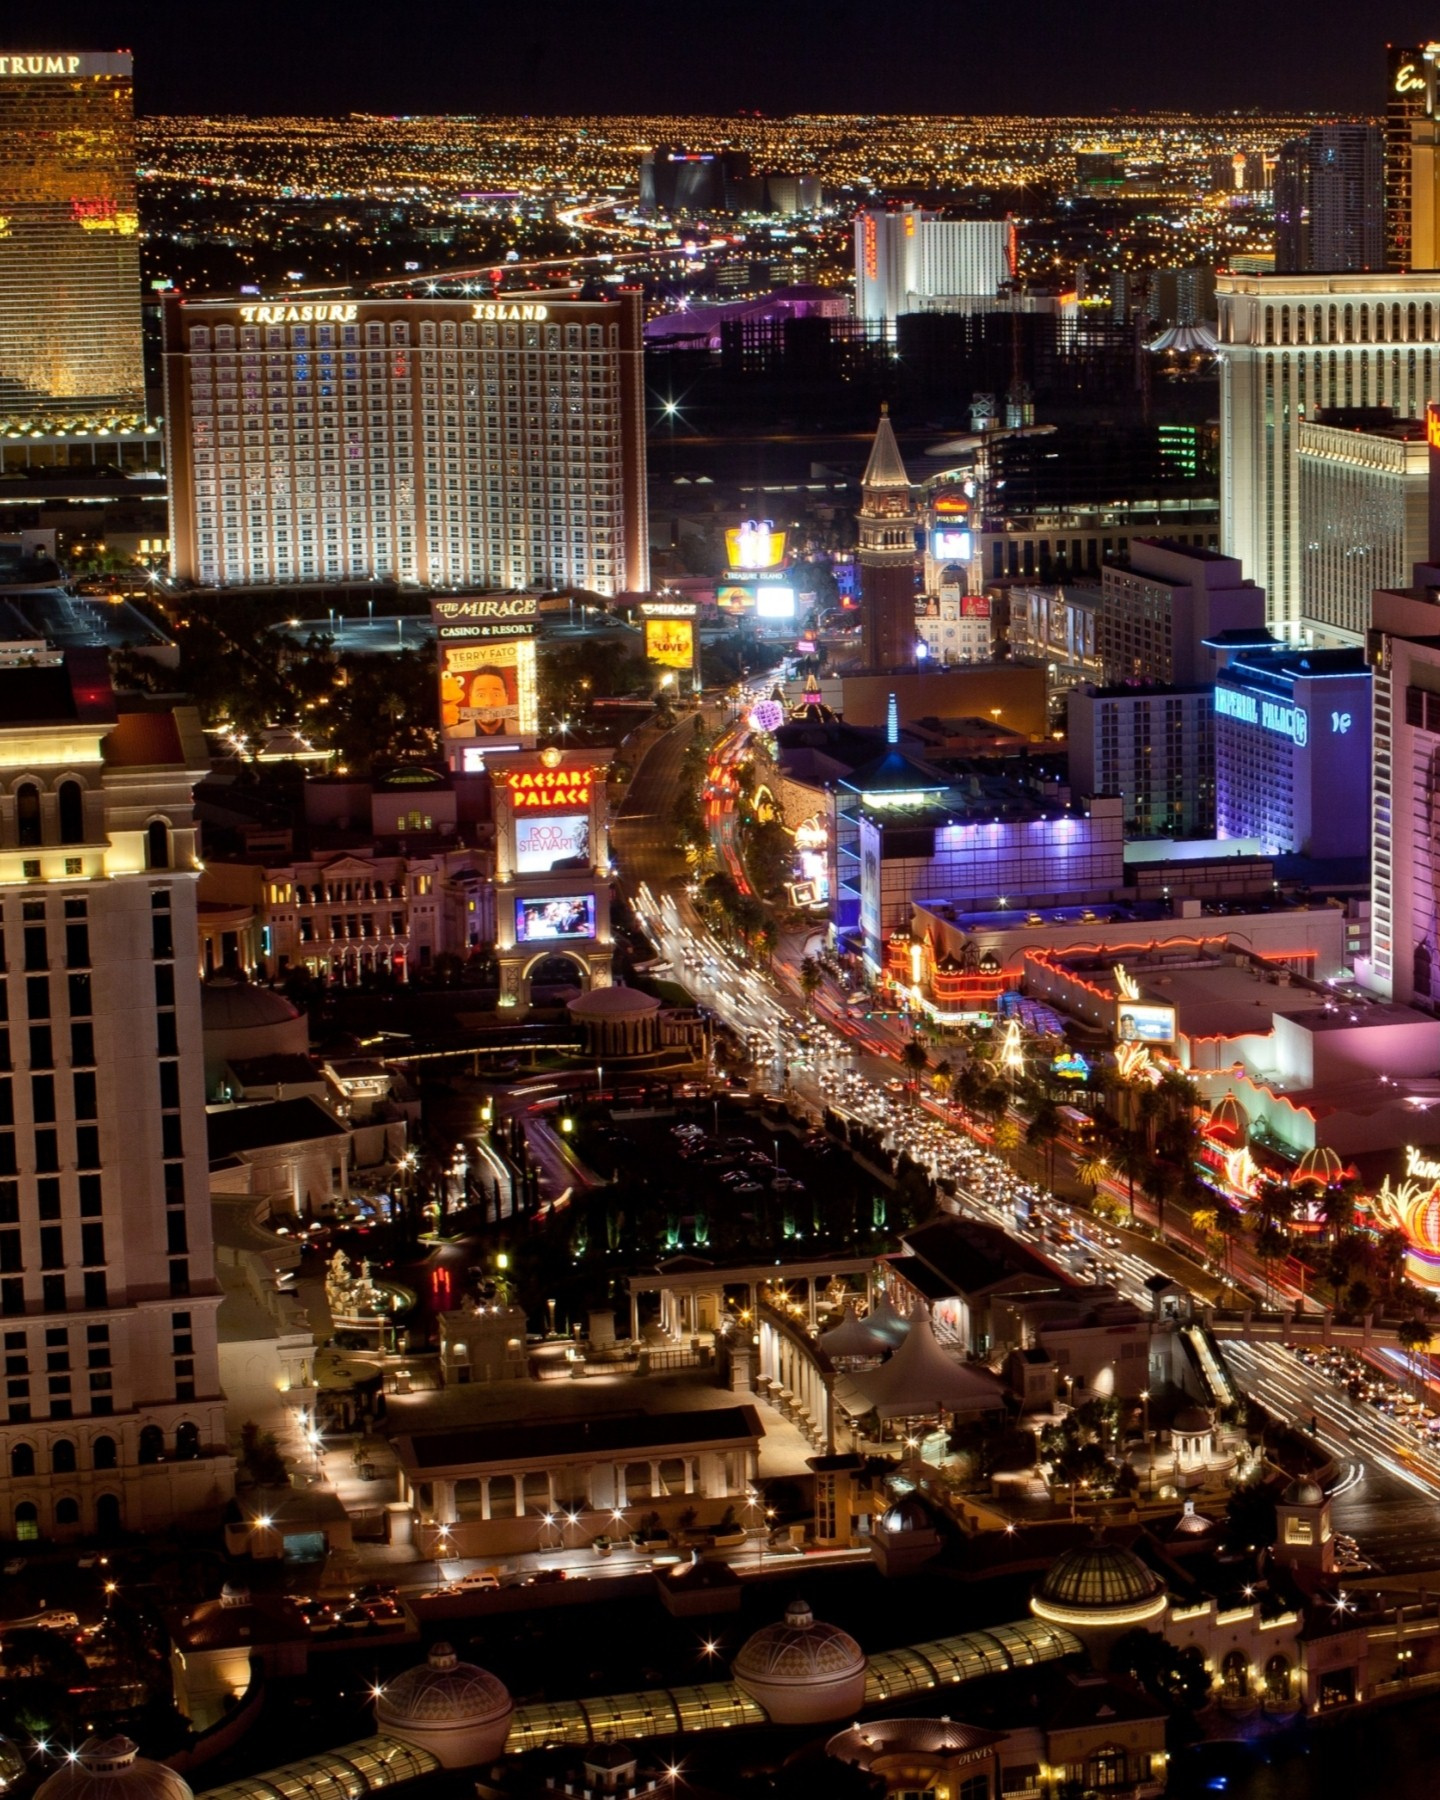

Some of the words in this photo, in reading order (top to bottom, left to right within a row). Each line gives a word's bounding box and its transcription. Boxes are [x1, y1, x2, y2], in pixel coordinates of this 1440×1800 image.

[0, 56, 80, 74] TRUMP
[240, 305, 358, 324] TREASURE
[472, 304, 548, 321] ISLAND
[727, 572, 757, 580] TREASURE
[760, 572, 783, 580] ISLAND
[458, 599, 537, 618] MIRAGE
[440, 626, 480, 637] CASINO
[481, 626, 490, 636] &
[492, 624, 534, 635] RESORT
[452, 650, 487, 662] TERRY
[490, 646, 516, 658] FATO
[657, 643, 683, 652] LOVE
[1215, 686, 1258, 724] IMPERIAL
[509, 771, 592, 789] CAESARS
[514, 788, 590, 807] PALACE
[530, 826, 563, 840] ROD
[519, 837, 574, 853] STEWART
